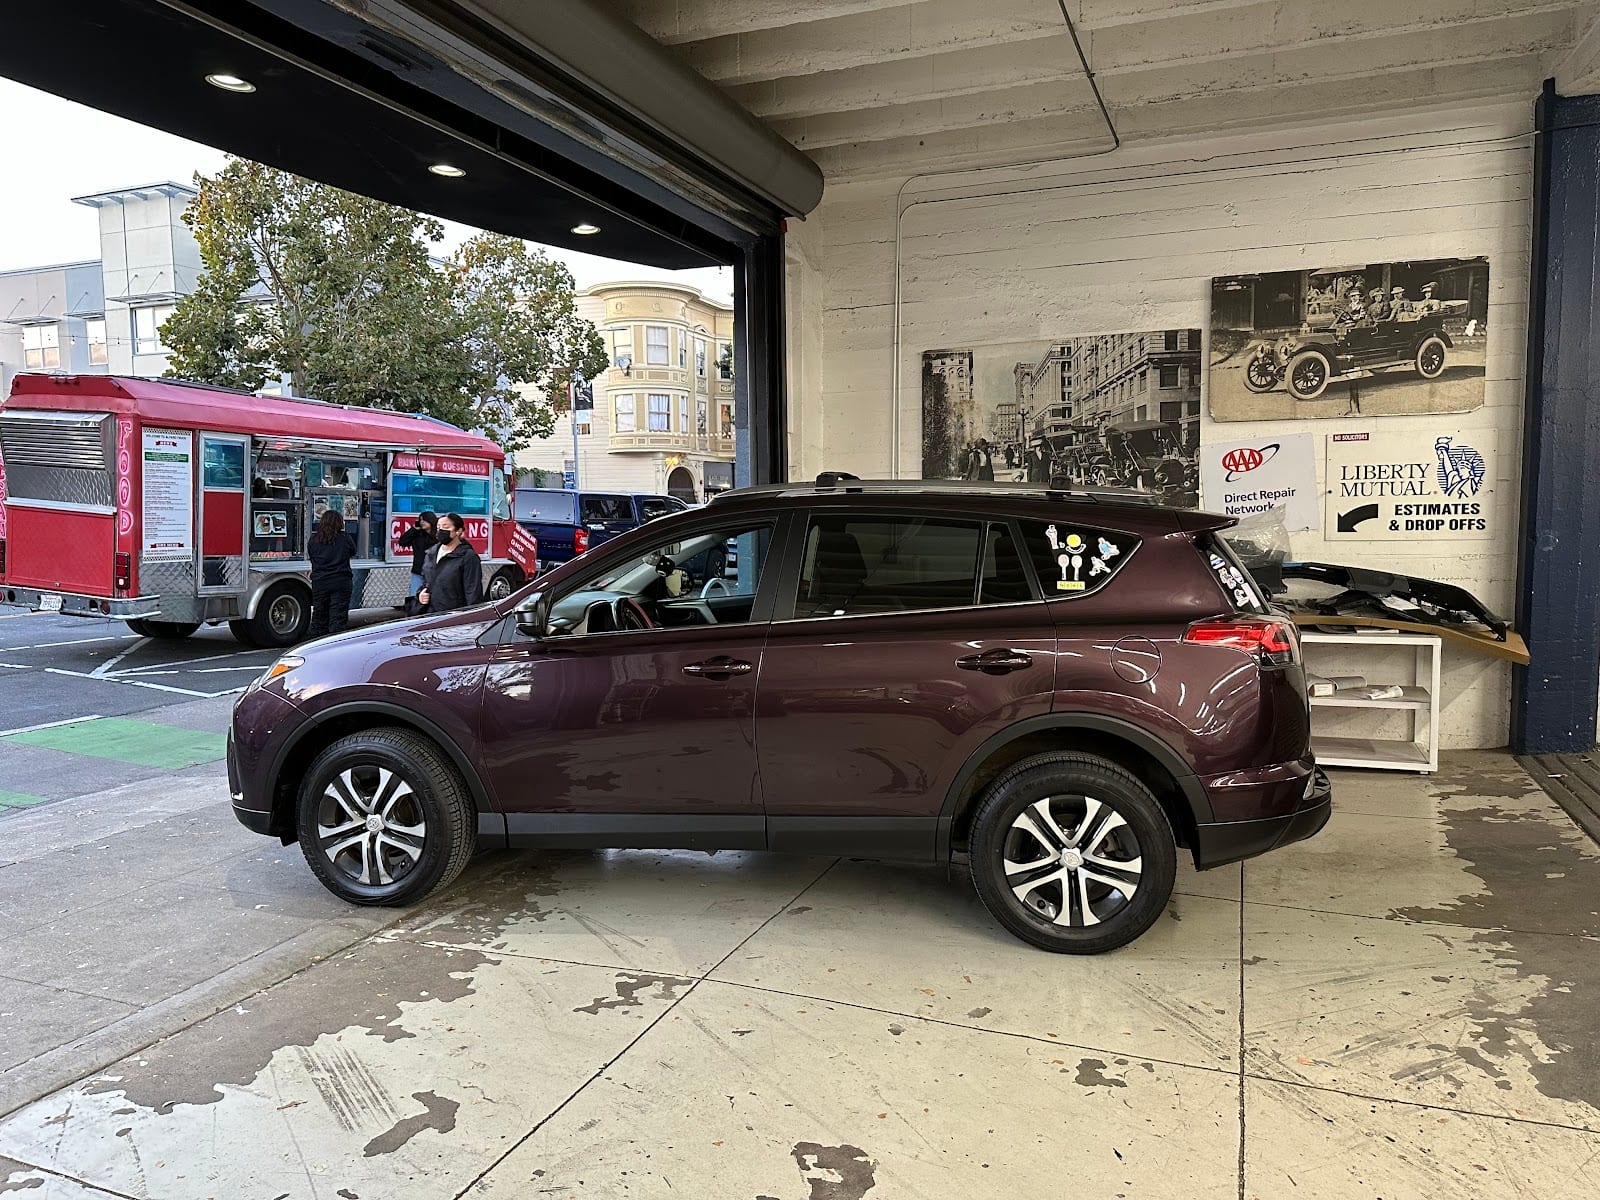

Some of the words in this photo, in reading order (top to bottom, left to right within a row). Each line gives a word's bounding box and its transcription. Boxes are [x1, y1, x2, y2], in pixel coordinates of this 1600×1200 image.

[1342, 433, 1368, 441] SOLICITORS
[1223, 448, 1262, 472] AAA
[119, 421, 133, 535] FOOD
[1340, 463, 1431, 480] LIBERTY
[1224, 492, 1258, 503] Direct
[1259, 487, 1296, 500] Repair
[1339, 480, 1432, 497] MUTUAL
[1225, 501, 1274, 515] Network
[1394, 503, 1481, 516] ESTIMATES
[1388, 519, 1400, 531] &
[1405, 518, 1445, 531] DROP
[1448, 518, 1486, 531] OFFS
